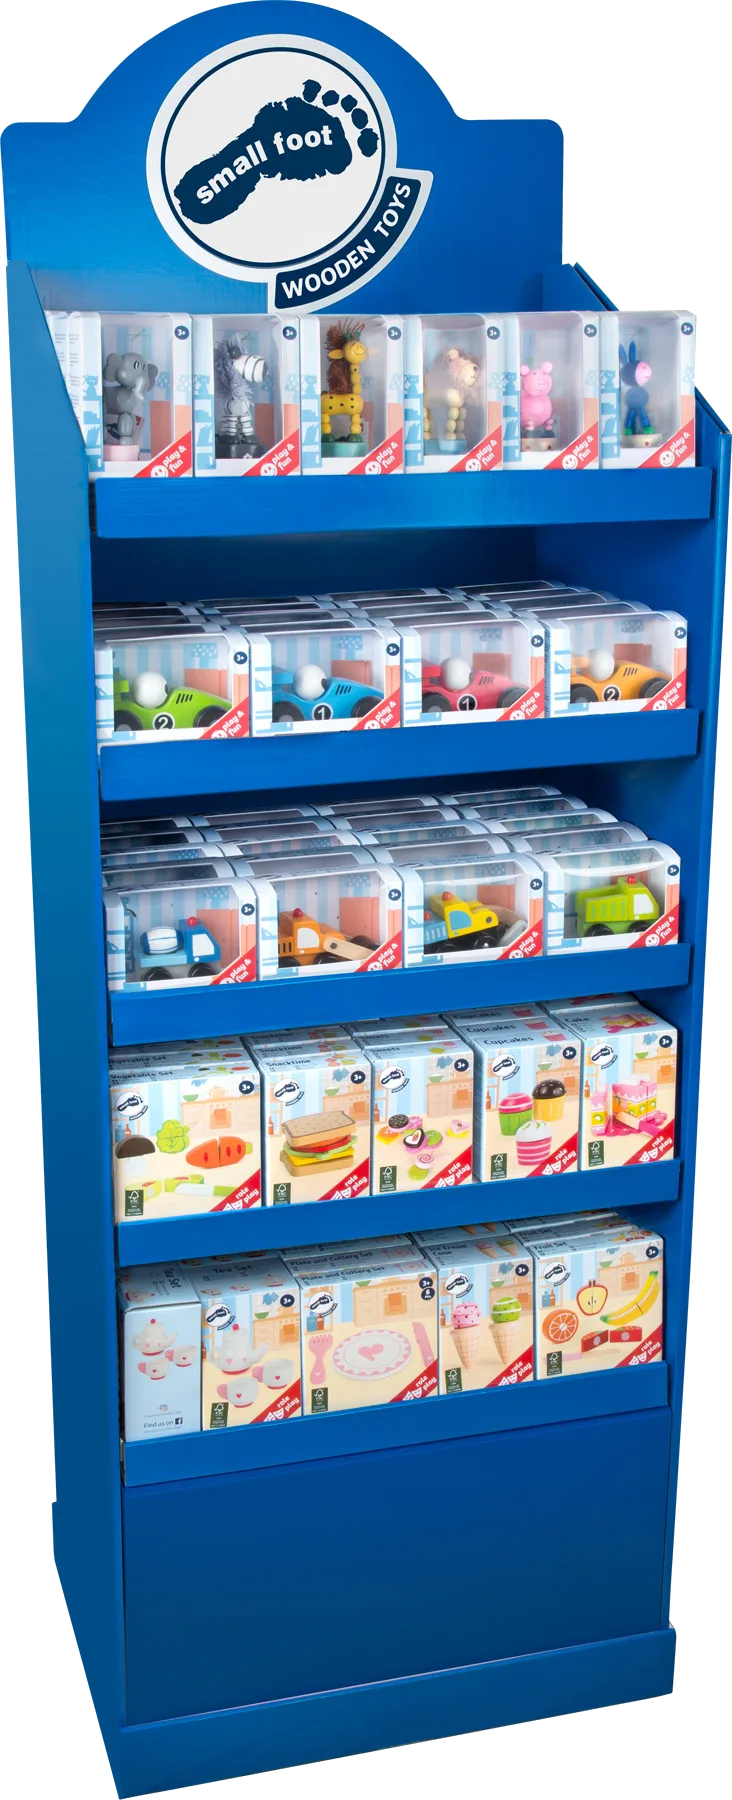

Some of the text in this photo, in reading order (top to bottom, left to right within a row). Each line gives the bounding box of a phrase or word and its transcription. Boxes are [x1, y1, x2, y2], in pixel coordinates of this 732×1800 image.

[196, 125, 332, 204] small foot
[282, 183, 411, 299] WOODEN TOYS
[573, 440, 589, 456] play
[670, 436, 685, 452] play
[675, 444, 687, 457] fun
[163, 450, 181, 466] play
[272, 449, 289, 464] play
[377, 446, 393, 462] play
[476, 444, 492, 460] play
[481, 452, 494, 466] fun
[578, 448, 591, 461] fun
[169, 458, 183, 472] fun
[278, 456, 292, 470] fun
[382, 455, 395, 468] fun
[608, 690, 616, 700] 2
[663, 681, 682, 701] play &
[464, 699, 470, 710] 1
[520, 691, 541, 712] play &
[668, 693, 680, 706] fun
[319, 708, 326, 720] 1
[375, 706, 391, 722] play
[525, 703, 538, 716] fun
[159, 718, 167, 729] 2
[223, 710, 244, 733] play &
[380, 714, 393, 726] fun
[228, 722, 242, 738] fun
[655, 921, 670, 935] play
[660, 926, 672, 940] fun
[519, 936, 535, 951] play
[524, 942, 536, 956] fun
[377, 948, 394, 962] play
[382, 954, 395, 968] fun
[230, 963, 247, 979] play
[236, 970, 249, 984] fun
[454, 1012, 502, 1020] Cupcakes
[466, 1023, 516, 1033] Cupcakes
[484, 1036, 534, 1045] Cupcakes
[652, 1136, 663, 1147] role
[658, 1138, 672, 1150] play
[554, 1149, 567, 1160] role
[562, 1150, 576, 1164] play
[448, 1162, 460, 1174] role
[456, 1164, 470, 1178] play
[345, 1174, 357, 1187] role
[352, 1177, 368, 1192] play
[235, 1187, 248, 1198] role
[243, 1188, 259, 1203] play
[641, 1340, 653, 1351] role
[647, 1341, 661, 1355] play
[511, 1360, 523, 1373] role
[518, 1363, 532, 1376] play
[416, 1375, 428, 1387] role
[422, 1376, 436, 1391] play
[277, 1396, 290, 1408] role
[284, 1398, 299, 1412] play
